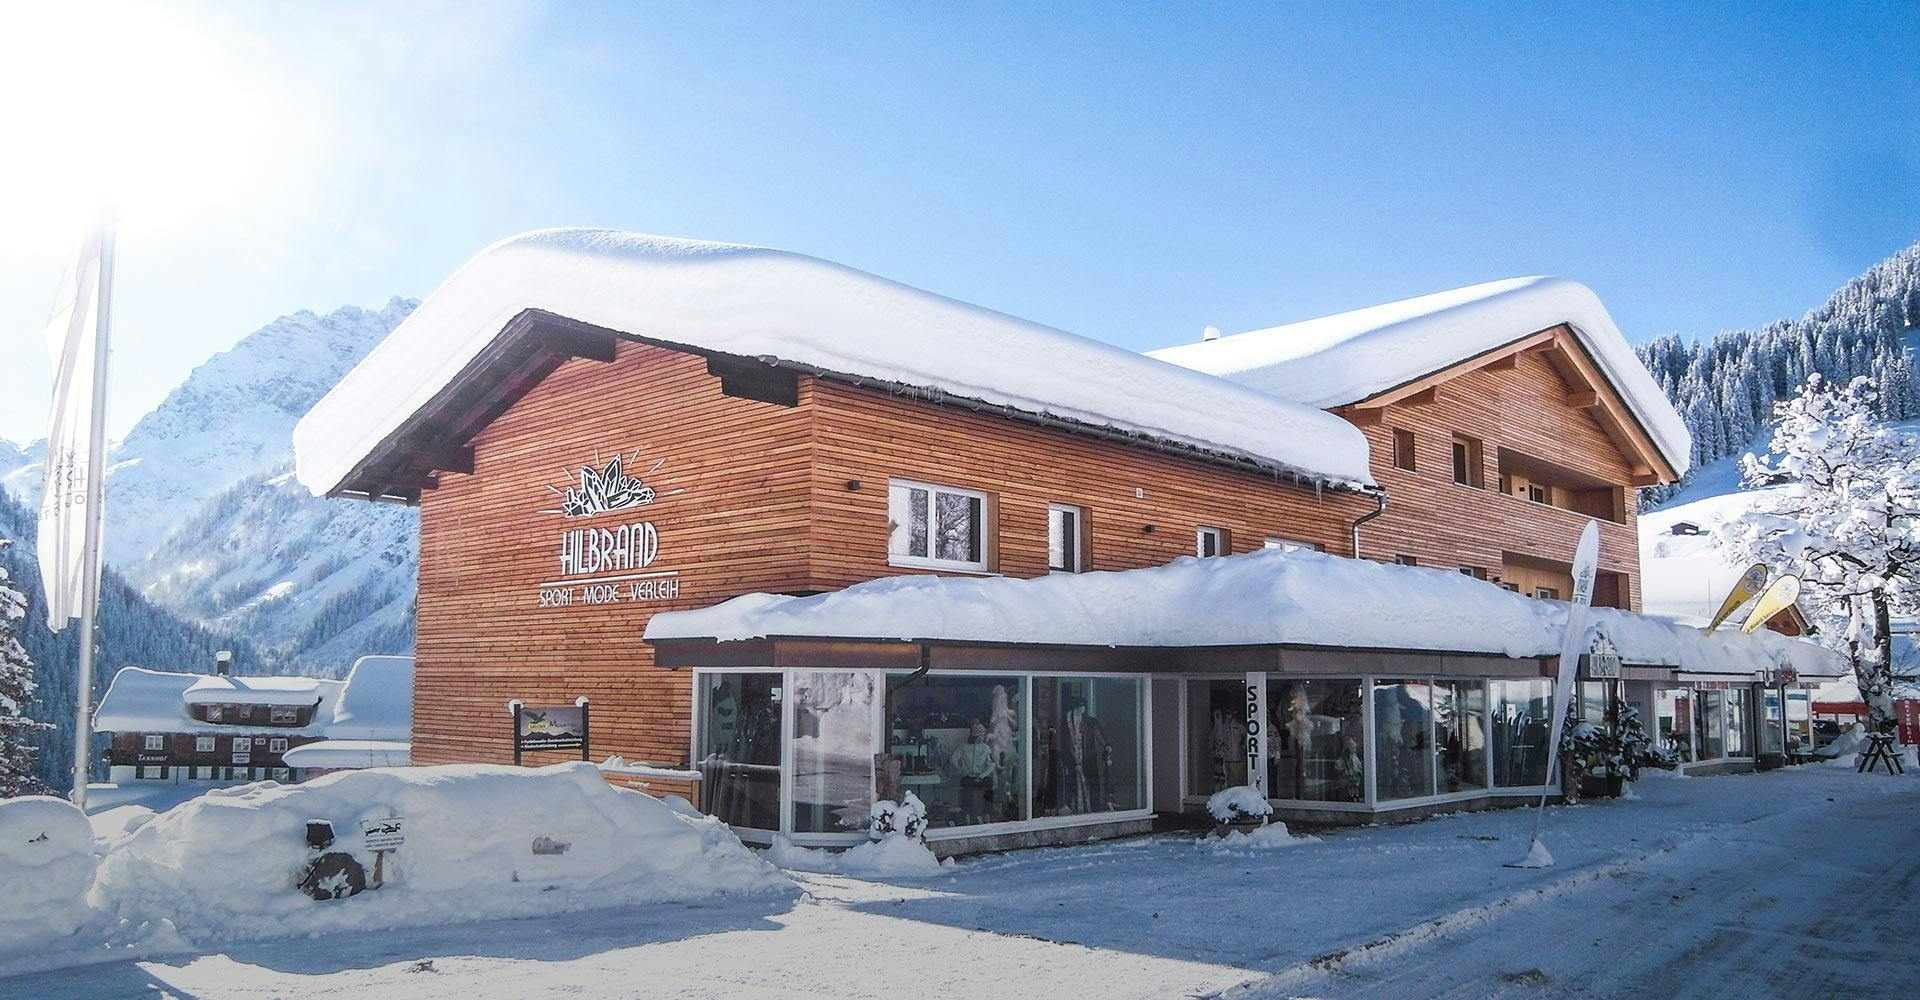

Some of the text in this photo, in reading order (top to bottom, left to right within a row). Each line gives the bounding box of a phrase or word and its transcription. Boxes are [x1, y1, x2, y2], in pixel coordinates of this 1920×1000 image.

[560, 522, 658, 576] HILBRAND
[539, 579, 679, 608] SPORT MODE VERLEIH
[1247, 685, 1260, 770] SPORT
